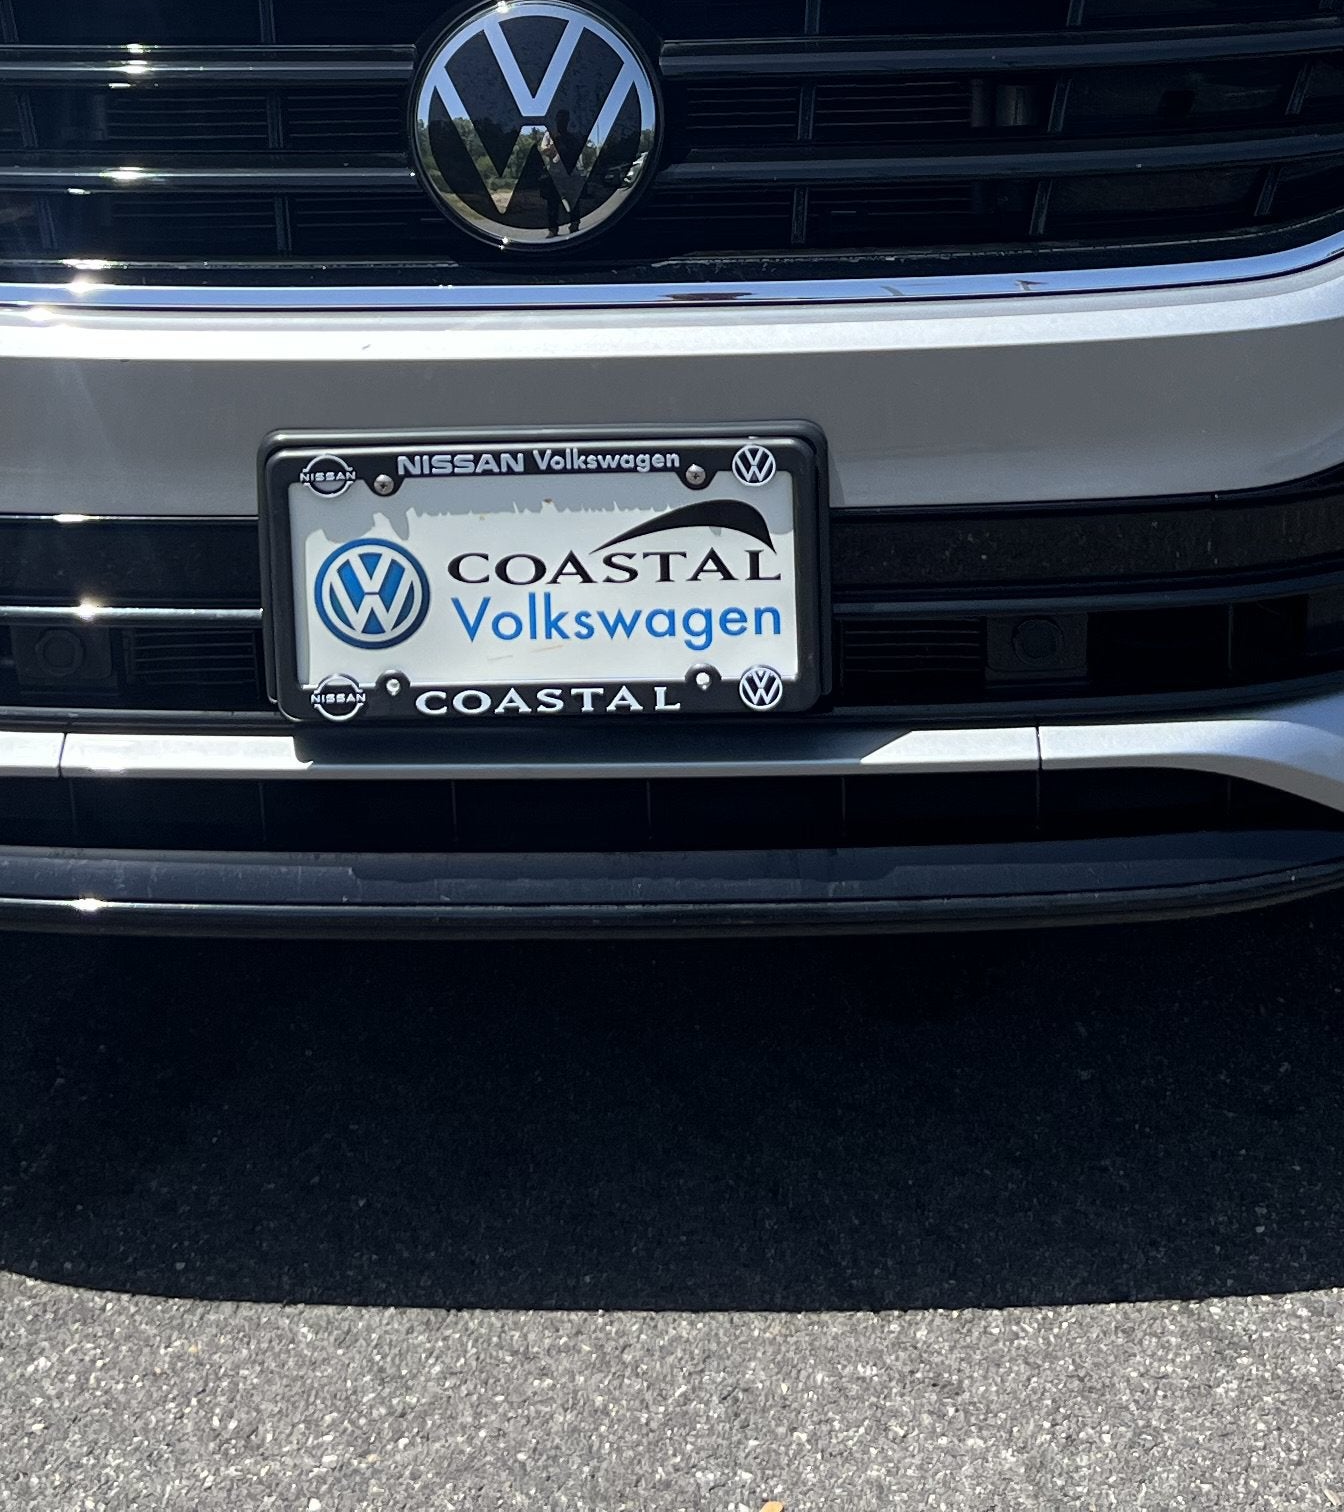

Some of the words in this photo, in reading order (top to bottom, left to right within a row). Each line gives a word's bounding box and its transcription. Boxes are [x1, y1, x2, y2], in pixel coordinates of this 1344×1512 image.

[397, 453, 524, 475] NISSAN
[533, 448, 680, 473] Volkswagen
[299, 470, 356, 482] NISSAN
[448, 547, 781, 585] COASTAL
[451, 591, 781, 651] Volkswagen
[310, 692, 366, 704] NISSAN
[415, 685, 681, 715] COASTAL
